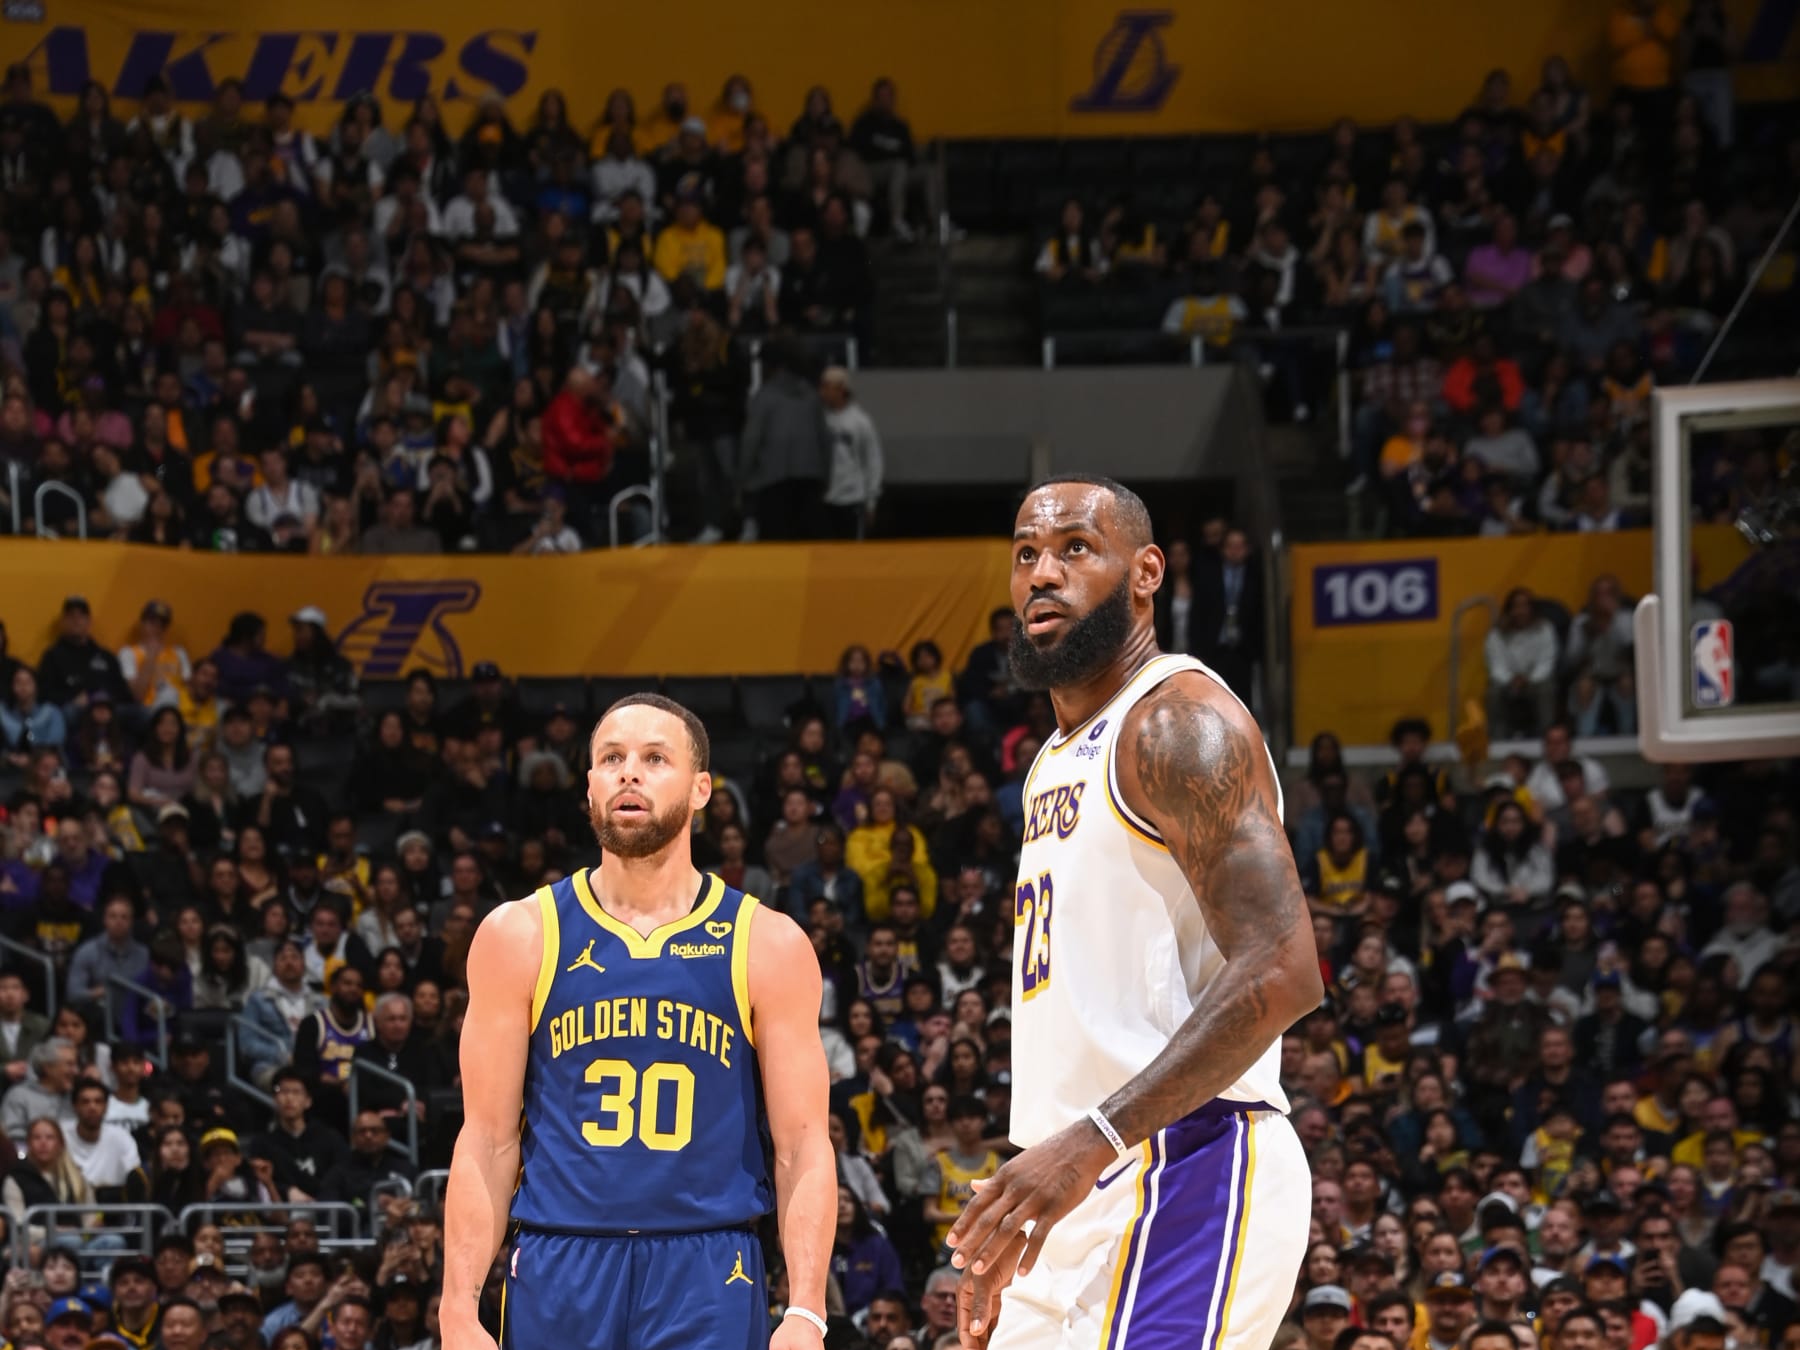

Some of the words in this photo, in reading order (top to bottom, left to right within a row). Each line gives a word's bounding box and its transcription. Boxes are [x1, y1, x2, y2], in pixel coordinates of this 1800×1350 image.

[1324, 566, 1429, 618] 106
[669, 942, 726, 959] Rakuten
[1014, 868, 1054, 1003] 23
[549, 998, 648, 1060] GOLDEN
[656, 1000, 736, 1070] STATE
[581, 1058, 697, 1152] 30
